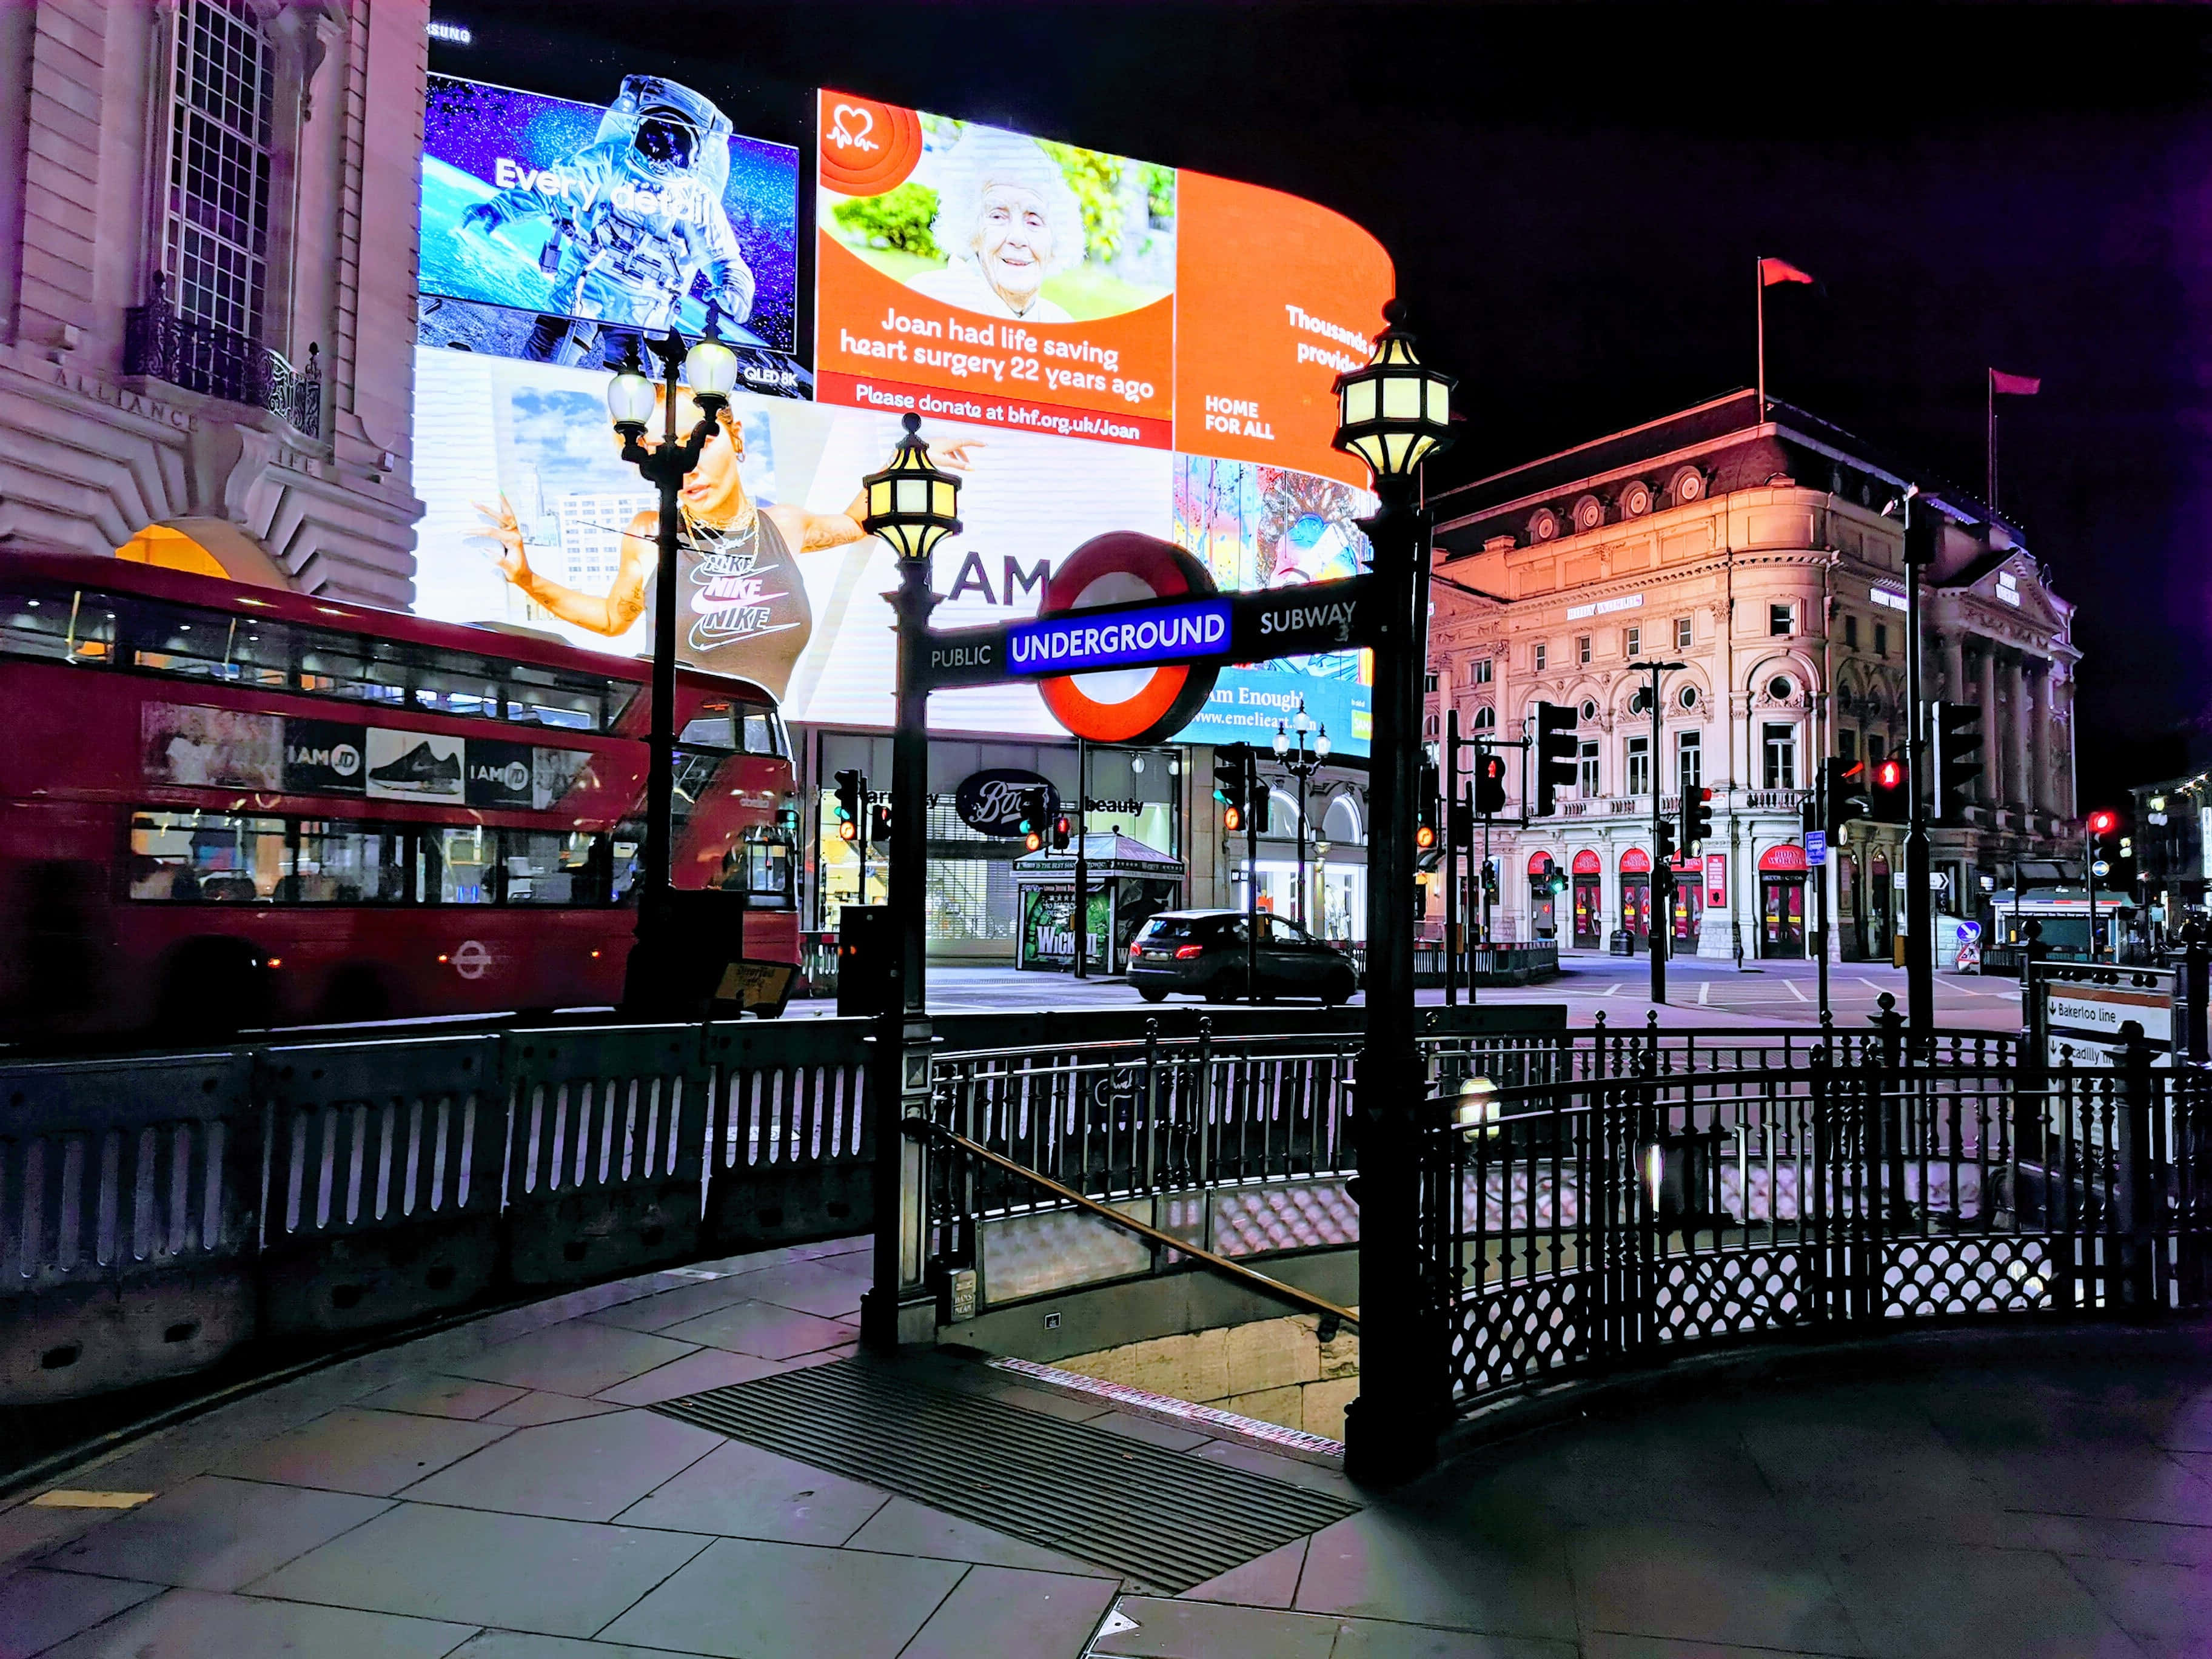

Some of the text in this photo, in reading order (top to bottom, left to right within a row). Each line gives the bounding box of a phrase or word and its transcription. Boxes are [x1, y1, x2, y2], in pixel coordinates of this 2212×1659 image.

[425, 23, 471, 43] SUNG
[495, 157, 708, 224] Every detail
[882, 307, 1118, 372] Joan had life saving
[1285, 304, 1367, 354] Thousands
[744, 367, 798, 387] QLED 8K
[840, 328, 1153, 403] heart surgery 22 years ago
[56, 367, 198, 432] ALLIANCE
[856, 384, 1140, 440] Please donate at bhf.org.uk/Joan
[1205, 395, 1258, 418] HOME
[1205, 415, 1275, 440] FOR ALL
[705, 577, 763, 599] NIKE
[948, 551, 1050, 606] AM
[703, 606, 771, 631] NIKE
[1261, 600, 1356, 634] SUBWAY
[1012, 614, 1225, 662] UNDERGROUND
[931, 645, 991, 668] PUBLIC
[297, 748, 329, 766] AM
[477, 767, 503, 782] AM
[1085, 796, 1144, 817] beauty
[1037, 927, 1097, 955] WICKD
[2059, 1003, 2116, 1022] Bakerloo line
